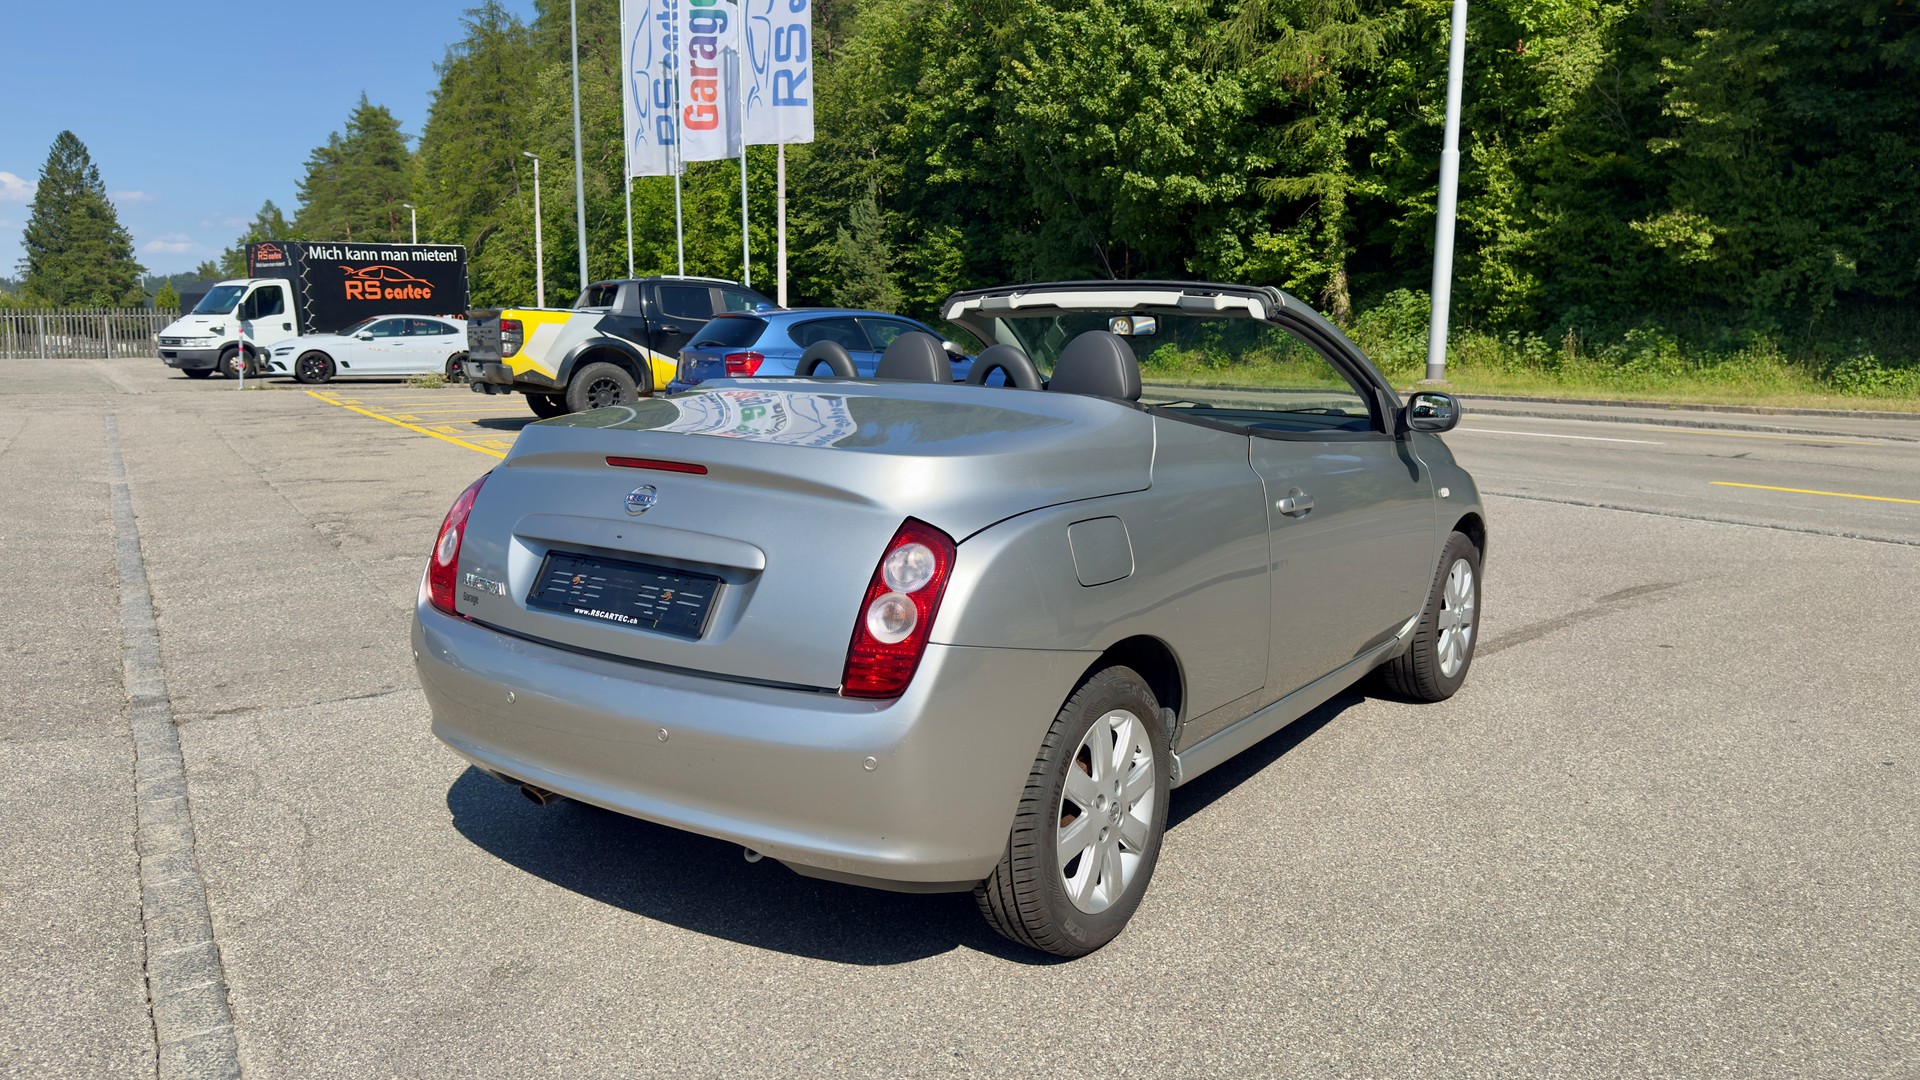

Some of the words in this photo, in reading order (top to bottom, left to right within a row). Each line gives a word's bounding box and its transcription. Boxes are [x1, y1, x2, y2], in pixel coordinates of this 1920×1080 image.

[683, 0, 728, 130] Garag
[772, 23, 808, 107] RS
[309, 245, 343, 260] Mich
[345, 247, 379, 261] kann
[382, 250, 409, 262] man
[412, 248, 458, 262] mieten!
[344, 280, 382, 300] RS
[384, 284, 432, 300] cartec
[574, 607, 638, 625] www.RSCARTEC.ch
[1058, 749, 1072, 776] PRO
